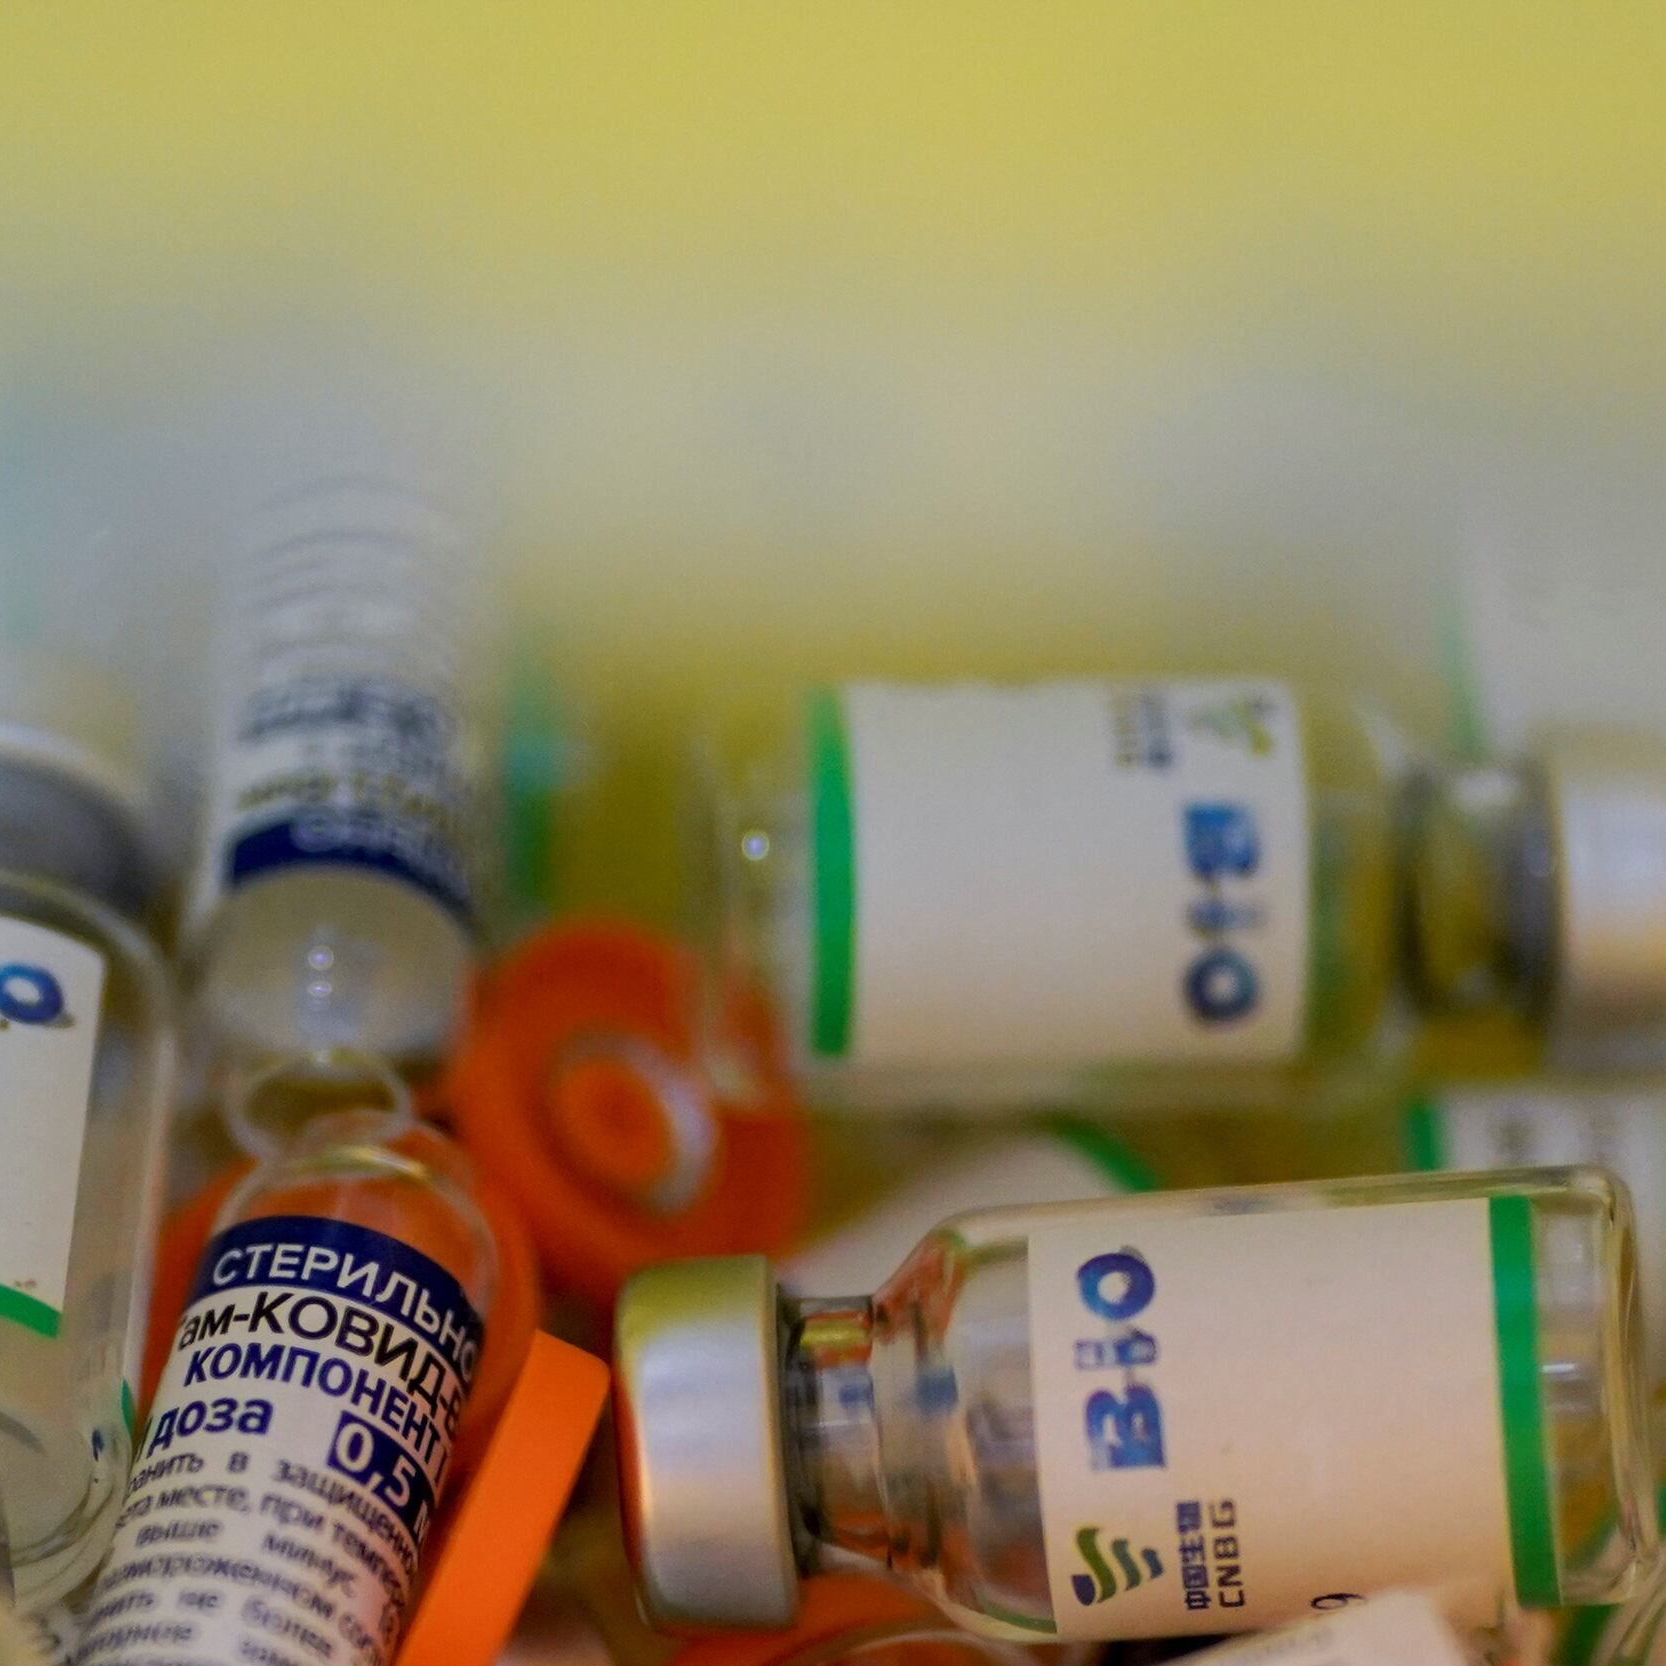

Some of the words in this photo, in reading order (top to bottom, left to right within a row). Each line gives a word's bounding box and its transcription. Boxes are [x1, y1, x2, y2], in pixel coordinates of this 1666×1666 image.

[147, 1397, 273, 1458] доза
[336, 1422, 416, 1507] 0,5
[1208, 1499, 1246, 1610] CNBG
